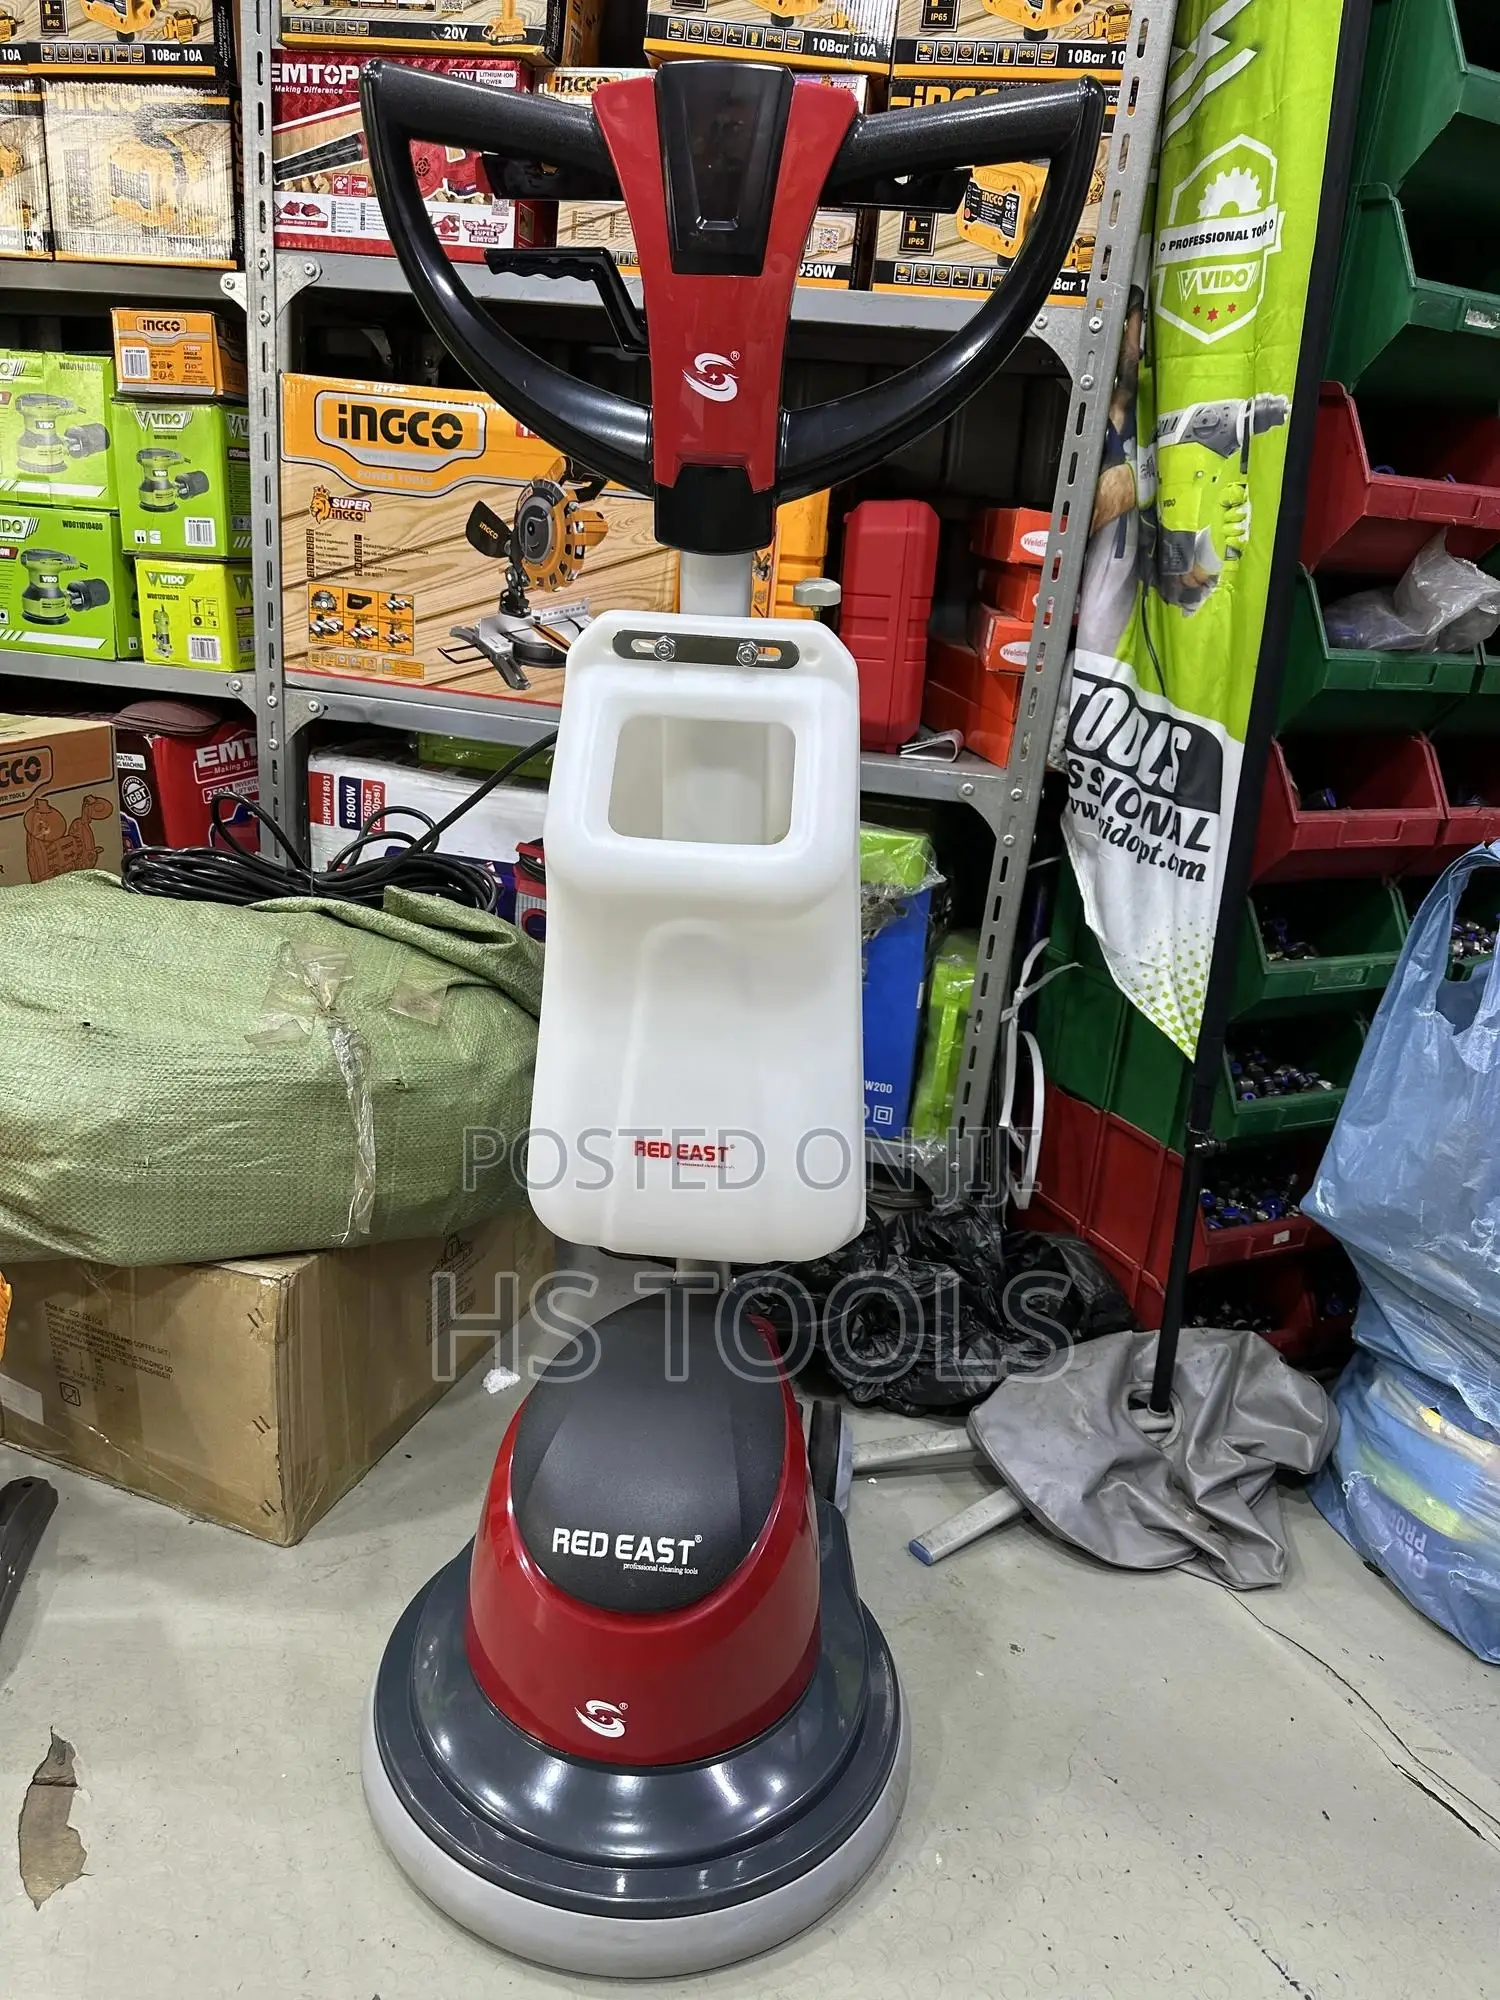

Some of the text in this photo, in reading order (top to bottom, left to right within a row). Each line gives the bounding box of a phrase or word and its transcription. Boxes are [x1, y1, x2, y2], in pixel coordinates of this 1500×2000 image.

[931, 12, 948, 21] IP65
[444, 27, 467, 40] 20V
[812, 37, 877, 57] 10Bar 10A
[2, 49, 21, 60] 10A
[151, 50, 203, 62] 10Bar 10A
[1067, 49, 1106, 64] 10Bar
[271, 63, 359, 85] EMTOP
[274, 86, 343, 94] Making Difference
[908, 237, 925, 246] IP65
[1168, 220, 1268, 251] PROFESSIONAL TOS
[1199, 268, 1249, 289] VIDO
[153, 411, 182, 423] VIDO
[332, 498, 371, 511] SUPER
[41, 575, 58, 583] VIDO
[160, 574, 185, 584] VIDO
[214, 763, 241, 774] Making
[126, 787, 147, 806] IGBT
[323, 775, 331, 825] EHPW1801
[345, 784, 356, 824] 1800W
[364, 787, 372, 821] 50bar
[634, 1140, 729, 1163] RED EAST
[552, 1527, 696, 1565] RED EAST
[623, 1562, 698, 1575] professional cleaning tools
